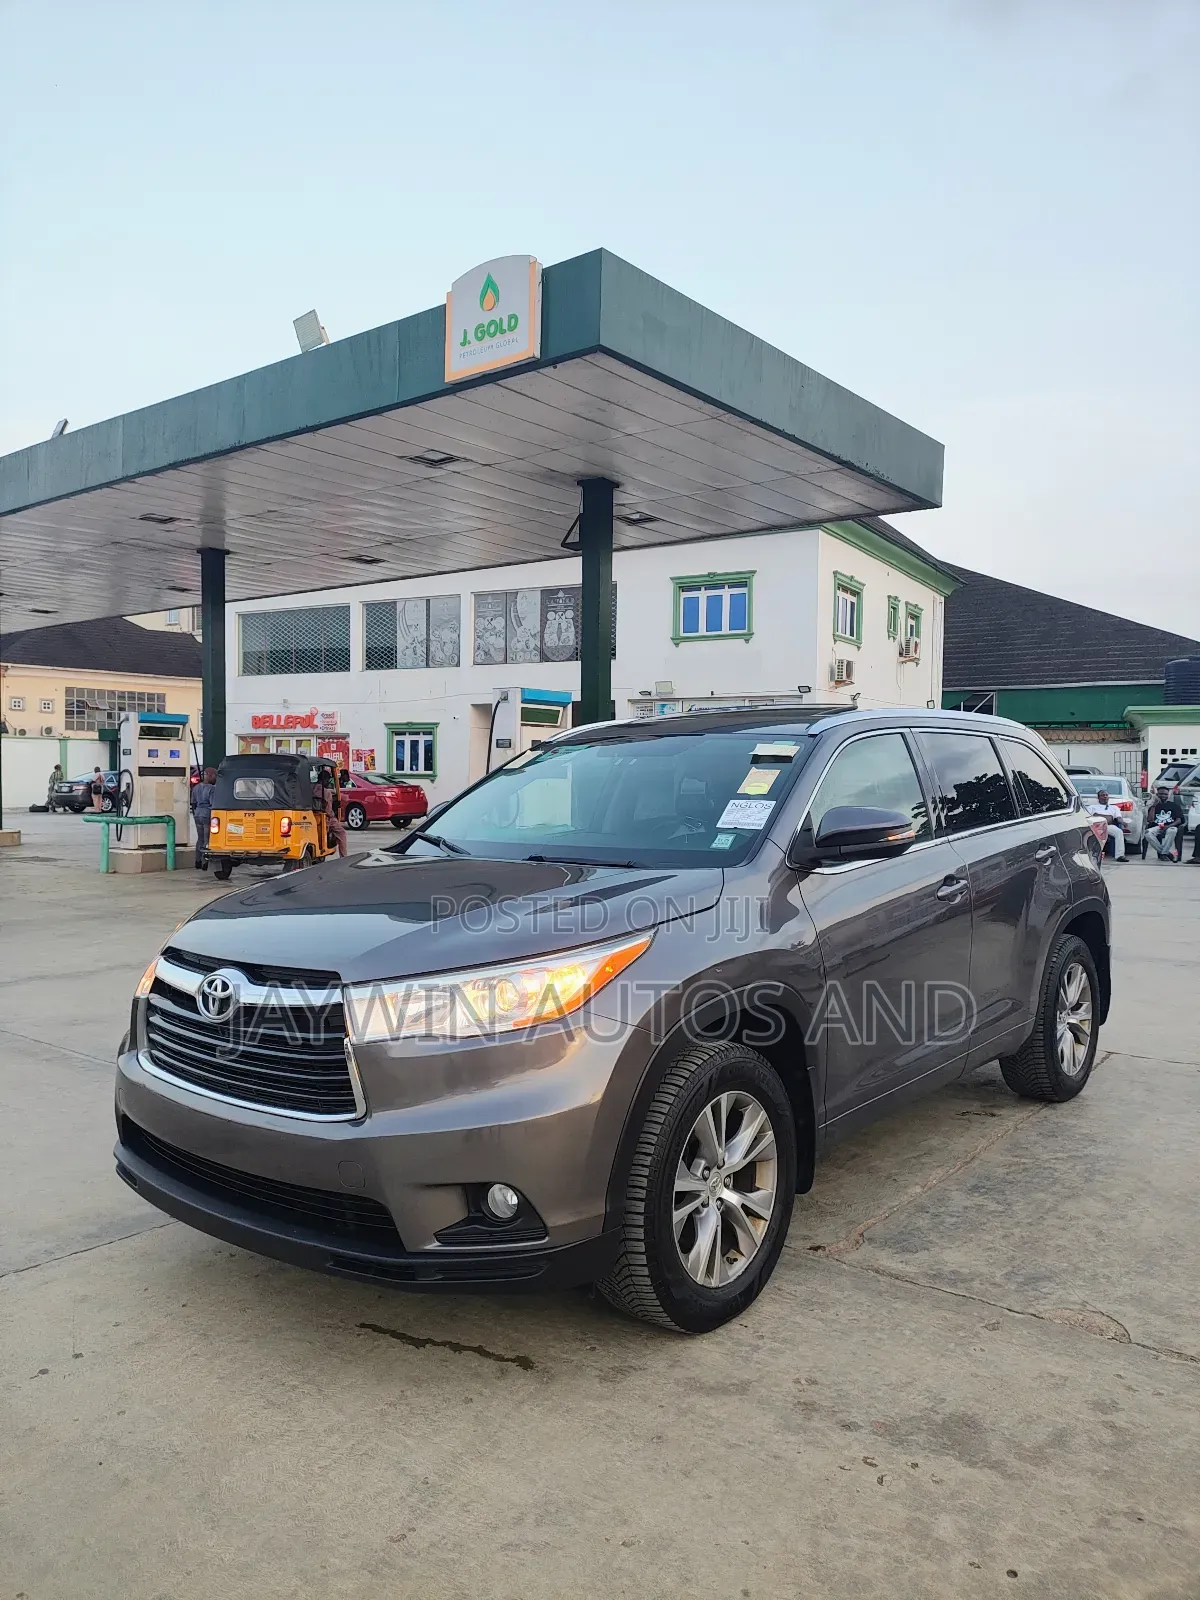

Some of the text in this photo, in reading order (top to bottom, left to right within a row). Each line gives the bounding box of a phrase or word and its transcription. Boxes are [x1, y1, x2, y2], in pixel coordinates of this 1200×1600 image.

[460, 313, 518, 346] J. GOLD
[460, 337, 518, 358] PETROLEUM GLOBAL
[252, 714, 318, 729] BELLEFUL
